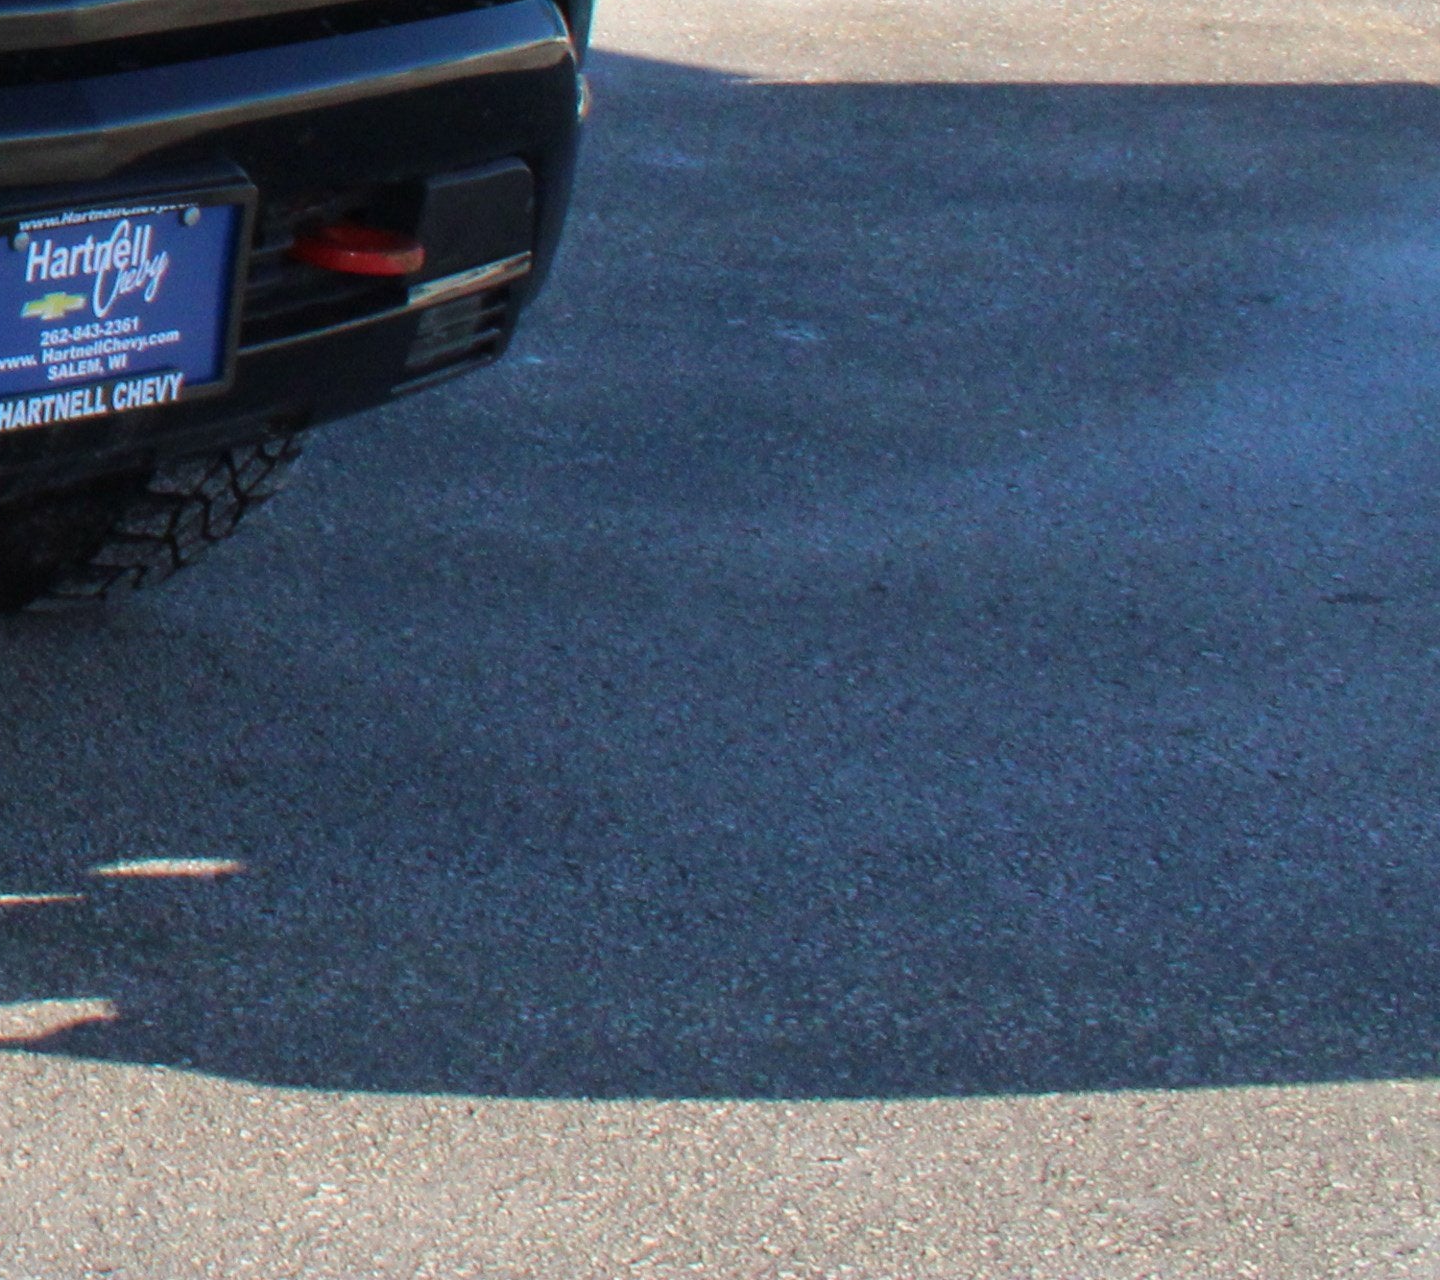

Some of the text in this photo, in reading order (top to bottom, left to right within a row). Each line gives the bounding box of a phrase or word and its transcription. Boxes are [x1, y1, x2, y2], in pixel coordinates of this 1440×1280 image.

[25, 224, 153, 283] Hartnell
[40, 316, 139, 347] 262-843-2361
[41, 329, 180, 364] HartnellChevy.com
[47, 353, 128, 381] SALEM, WI
[112, 371, 184, 411] CHEVY
